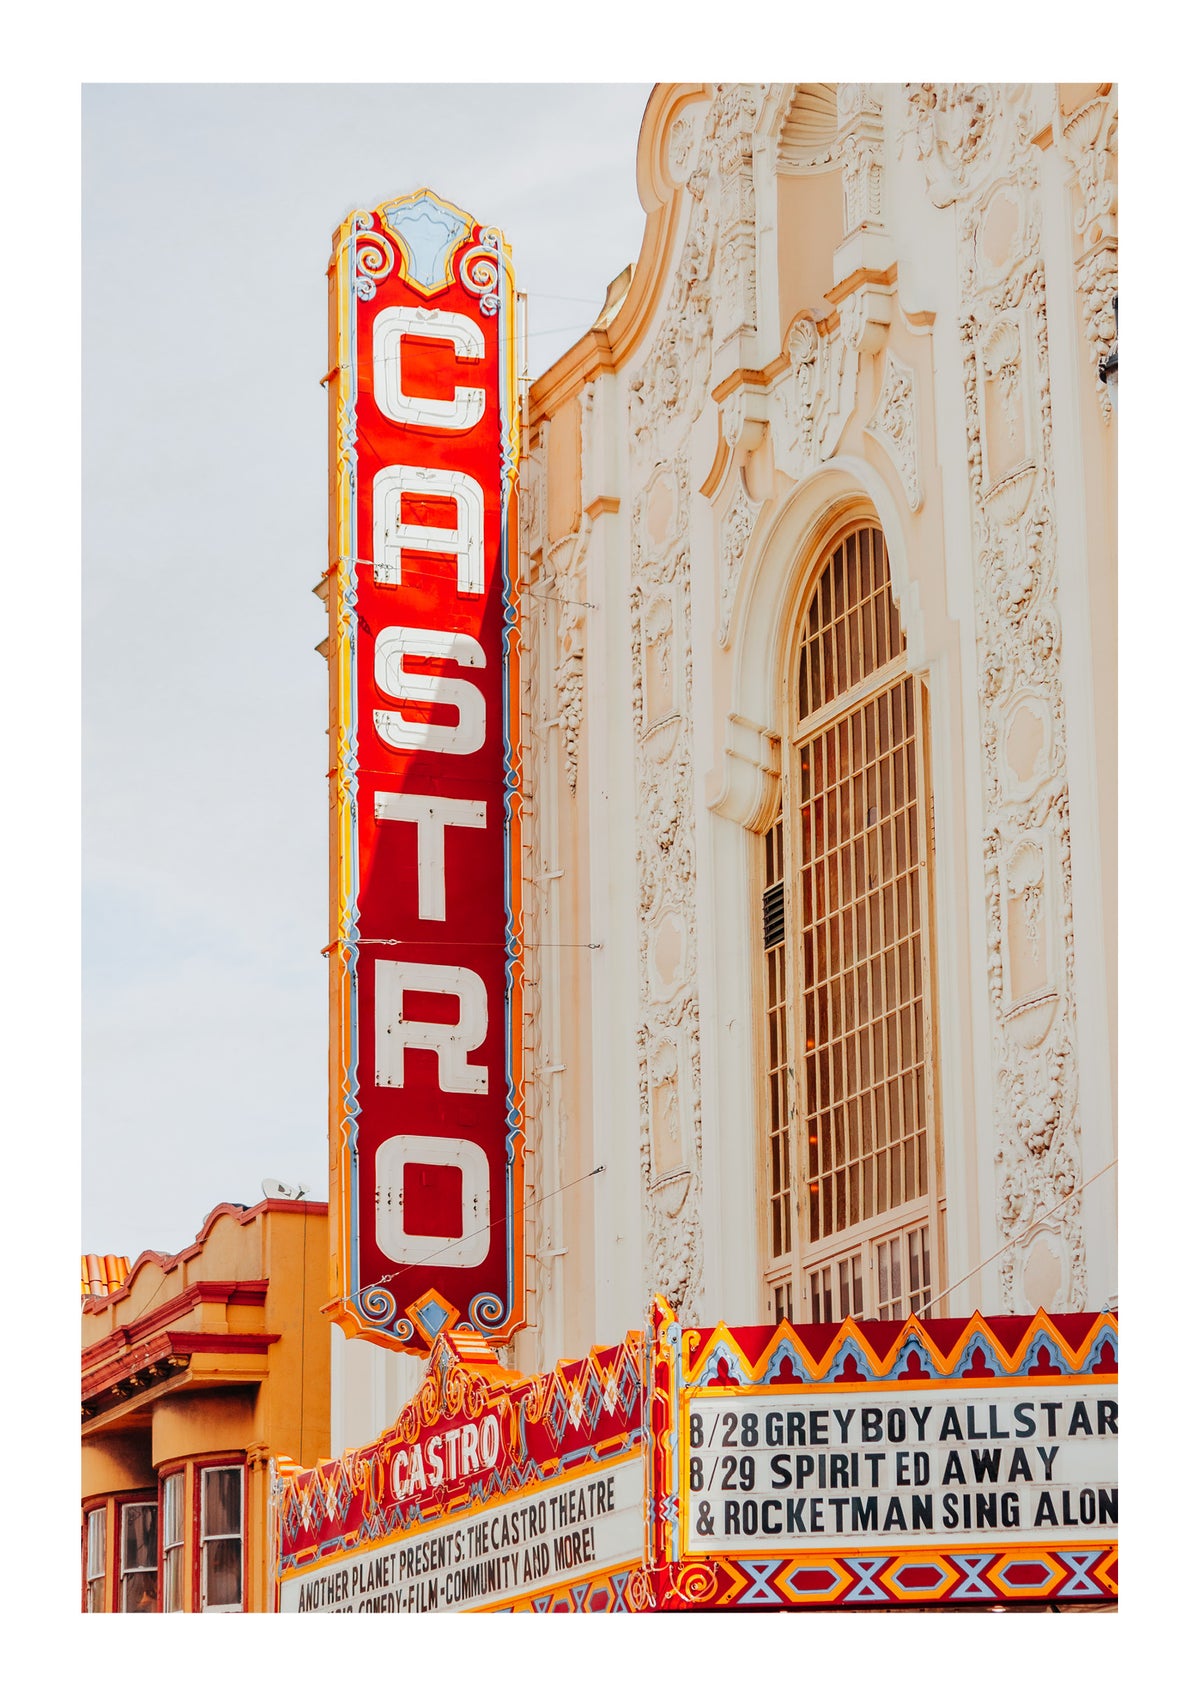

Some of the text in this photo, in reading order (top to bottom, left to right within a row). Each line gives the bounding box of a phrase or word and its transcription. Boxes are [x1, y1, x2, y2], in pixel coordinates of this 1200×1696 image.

[373, 306, 490, 1268] CASTRO
[392, 1414, 499, 1500] CASTRO
[690, 1412, 759, 1448] 8/28
[690, 1455, 755, 1492] 8/29
[942, 1446, 1059, 1485] AWAY
[696, 1488, 1118, 1536] & ROCKETMAN SING ALON
[299, 1477, 615, 1613] ANOTHER PLANET PRESENTS: THE CASTRO THEATRE
[523, 1543, 550, 1582] AND
[554, 1526, 595, 1571] MORE!
